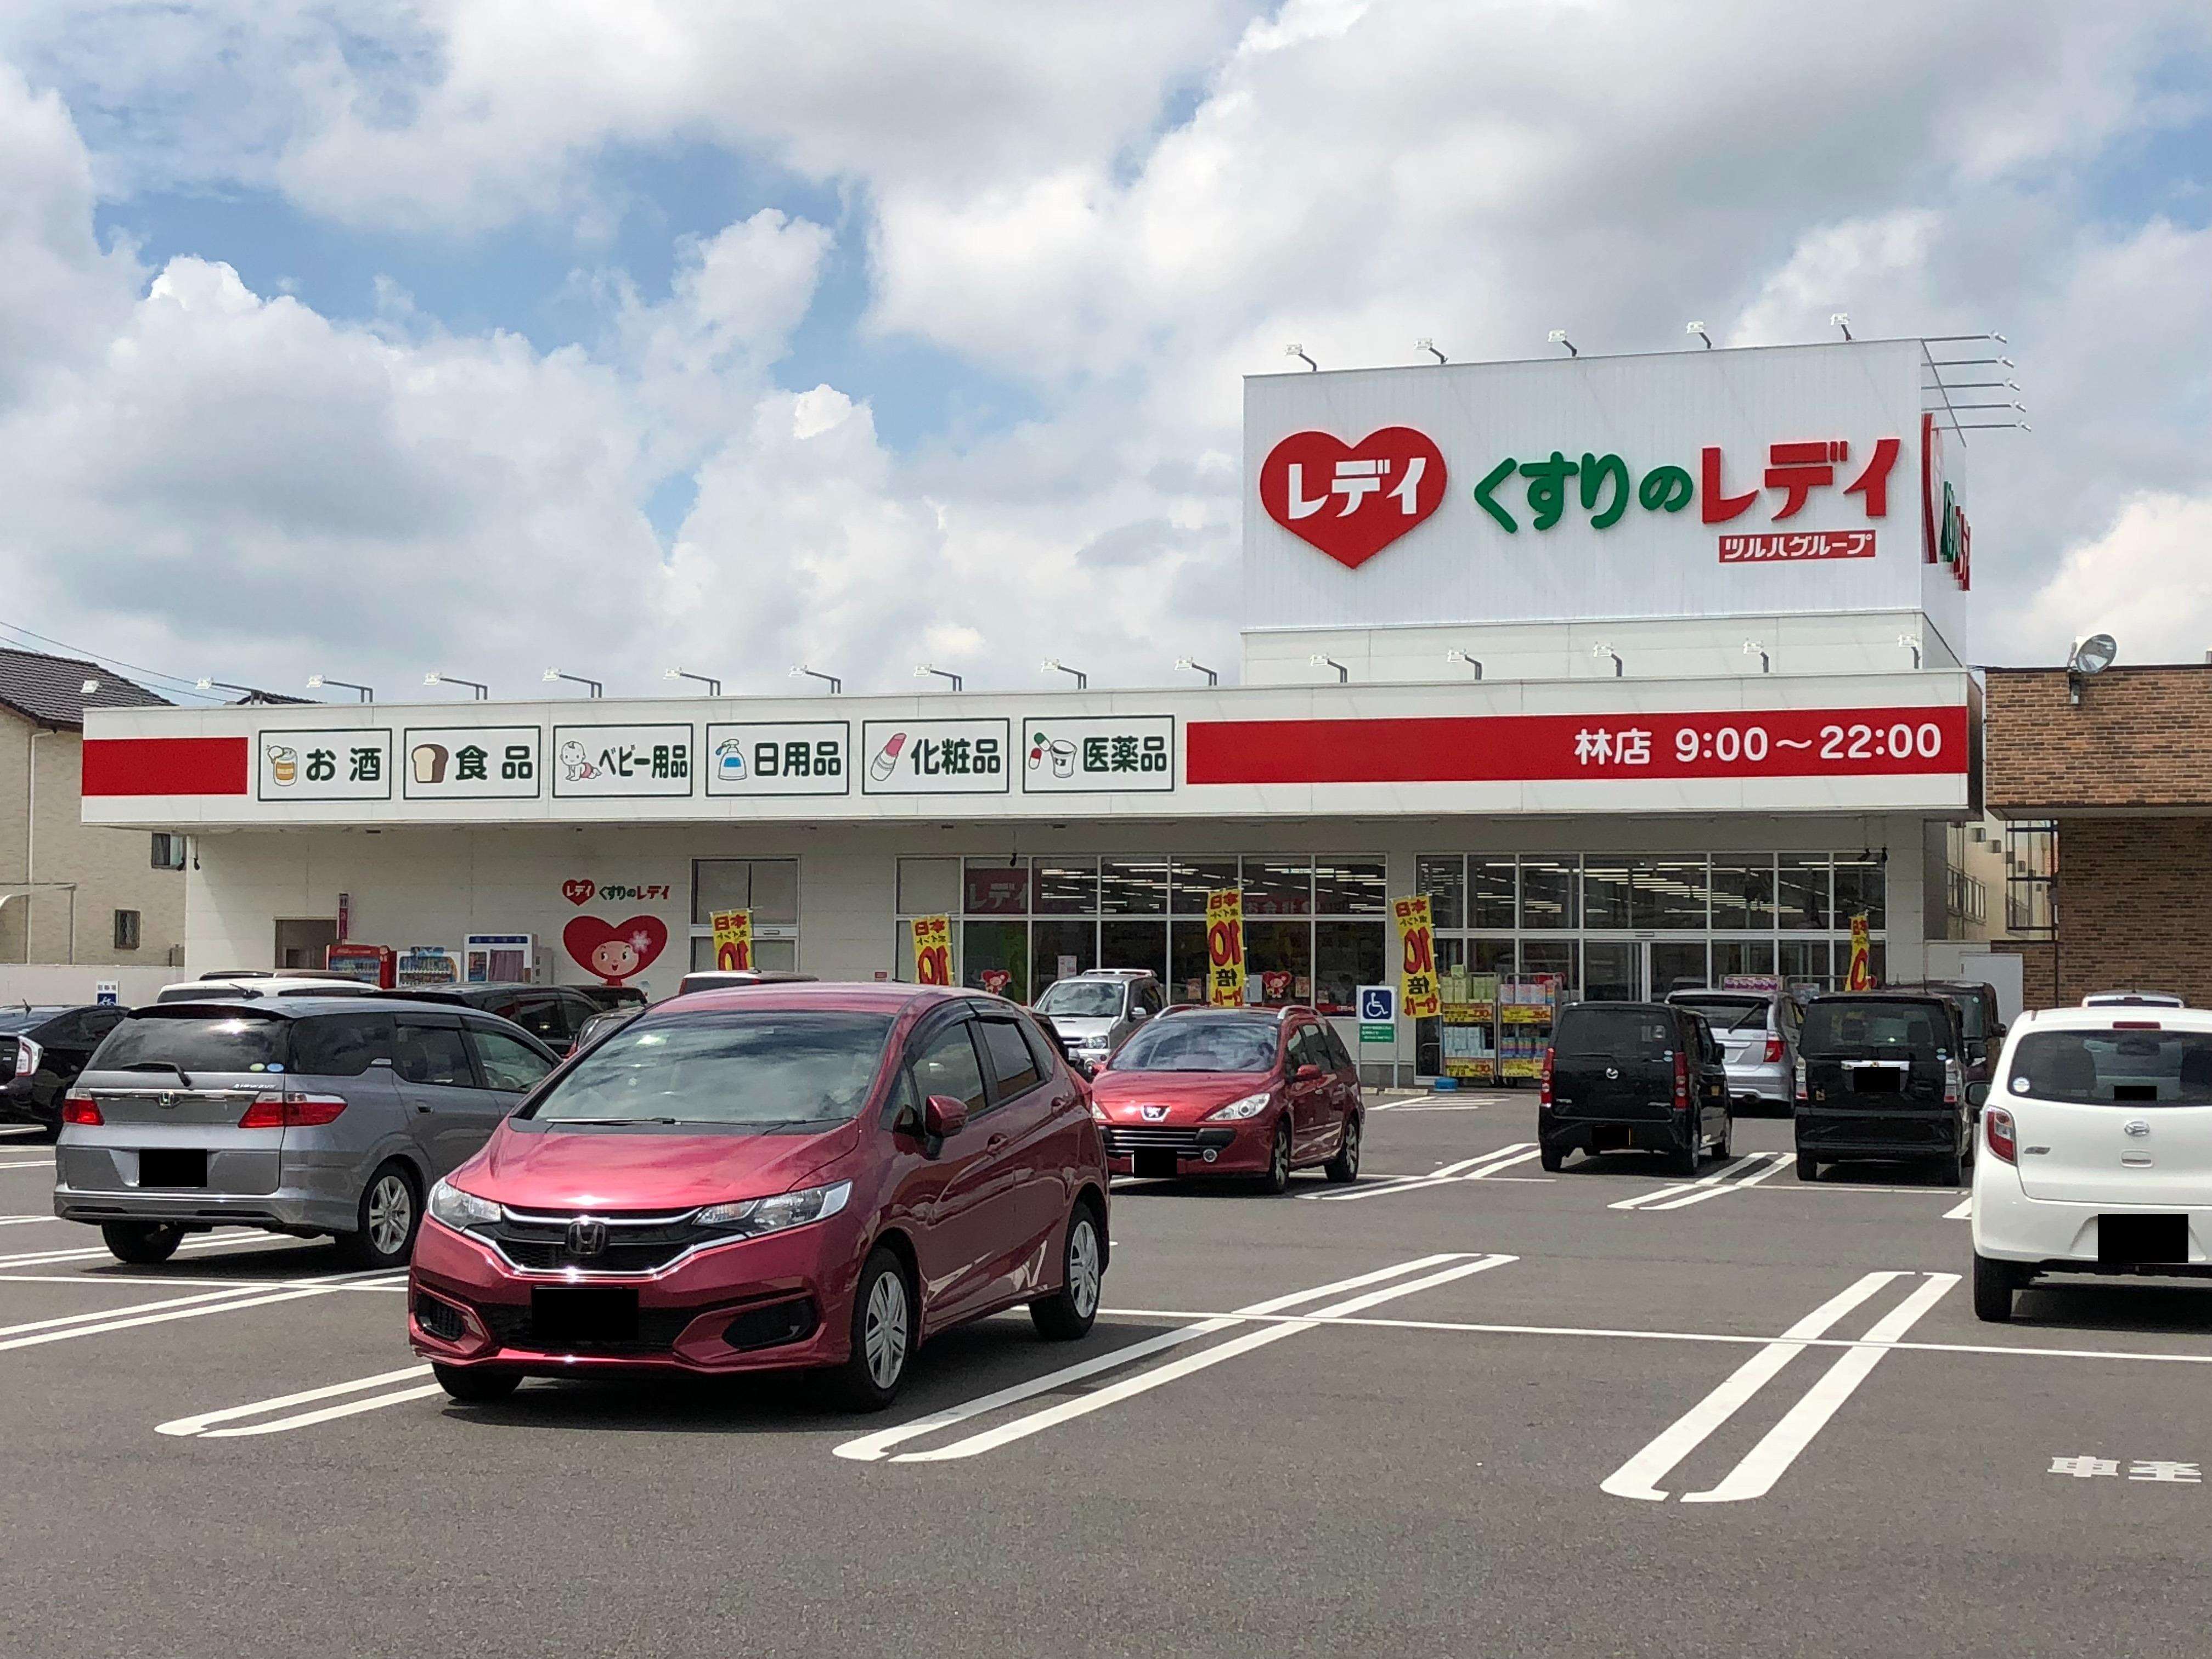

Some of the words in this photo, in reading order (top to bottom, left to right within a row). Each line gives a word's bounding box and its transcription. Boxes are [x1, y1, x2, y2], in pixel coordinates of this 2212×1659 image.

[1288, 458, 1426, 520] レディ
[1474, 438, 1901, 534] くすりのレディ
[1724, 534, 1872, 560] ツルハグループ
[455, 745, 533, 781] 食品
[599, 744, 688, 779] ベビー用品
[755, 741, 842, 777] 日用品
[910, 738, 1001, 776] 化粧品
[1083, 736, 1167, 774] 医薬品
[1575, 728, 1652, 765] 林店
[306, 748, 382, 782] お酒
[567, 885, 591, 896] レディ
[599, 885, 670, 900] くすりのレディ
